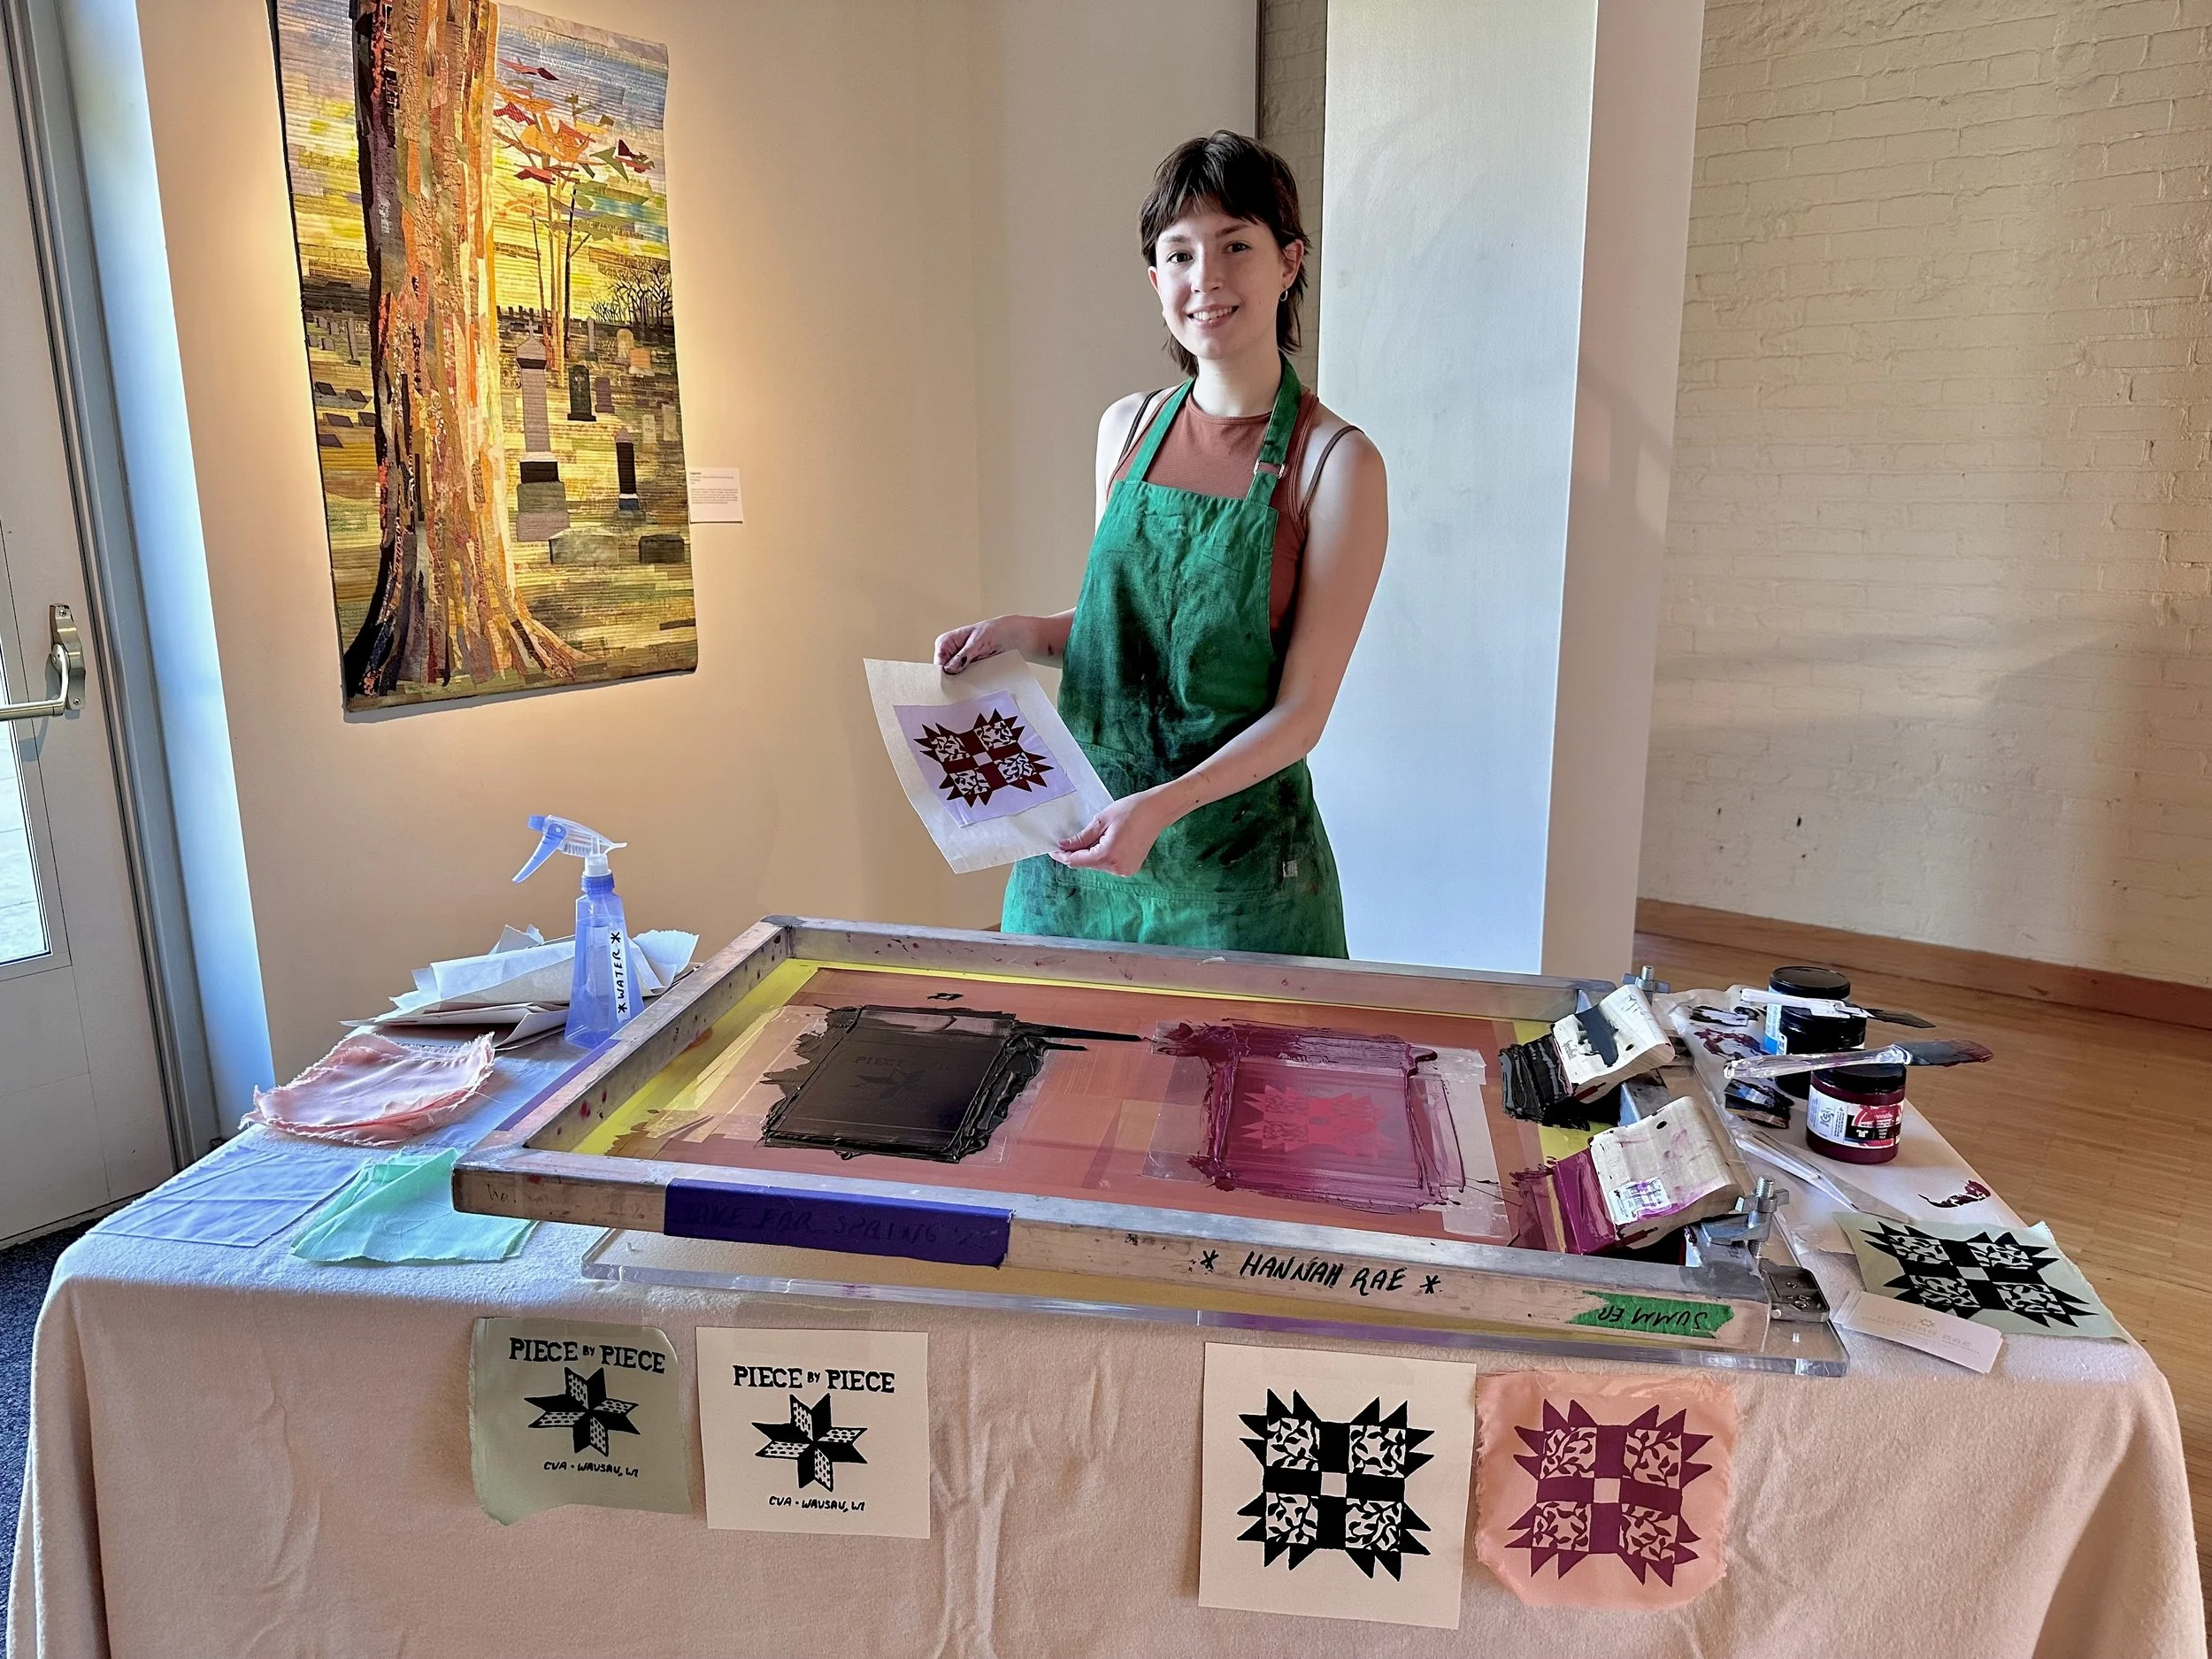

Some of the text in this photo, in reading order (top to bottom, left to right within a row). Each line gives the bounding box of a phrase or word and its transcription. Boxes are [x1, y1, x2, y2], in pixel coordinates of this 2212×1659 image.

[611, 949, 626, 1000] WATER
[1239, 1249, 1408, 1296] HANNAH RAE
[1596, 1304, 1709, 1331] SUMMER
[508, 1337, 666, 1375] PIECE BY PIECE
[732, 1364, 895, 1394] PIECE BY PIECE
[577, 1462, 624, 1478] WAUSAU,
[625, 1466, 639, 1478] WI
[801, 1499, 849, 1513] WAUSAU,
[850, 1501, 865, 1511] WI
